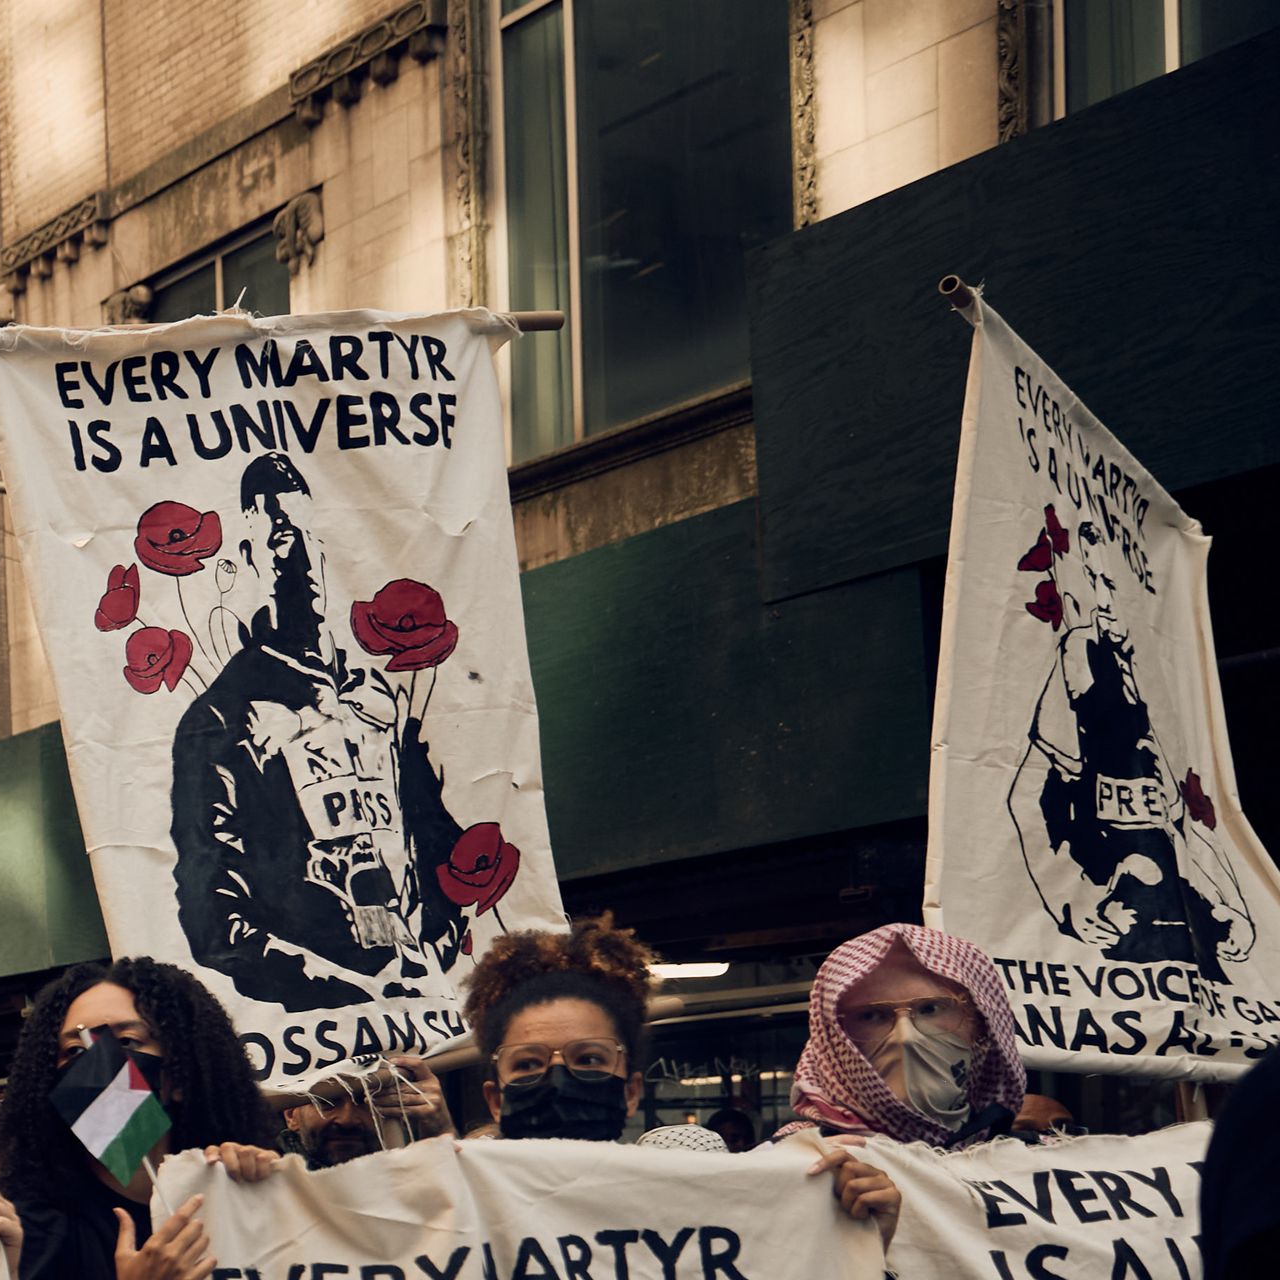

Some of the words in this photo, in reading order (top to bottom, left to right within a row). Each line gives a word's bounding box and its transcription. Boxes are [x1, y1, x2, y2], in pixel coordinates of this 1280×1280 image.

[55, 347, 221, 409] EVERY
[235, 331, 456, 389] MARTYR
[68, 419, 122, 473] IS
[140, 416, 178, 467] A
[186, 391, 457, 461] UNIVERSE
[1015, 366, 1072, 453] EVERY
[1048, 447, 1063, 495] A
[993, 957, 1071, 997] THE
[1073, 964, 1201, 1004] VOICE
[239, 1011, 428, 1081] OSSAM
[966, 1166, 1185, 1229] EVERY
